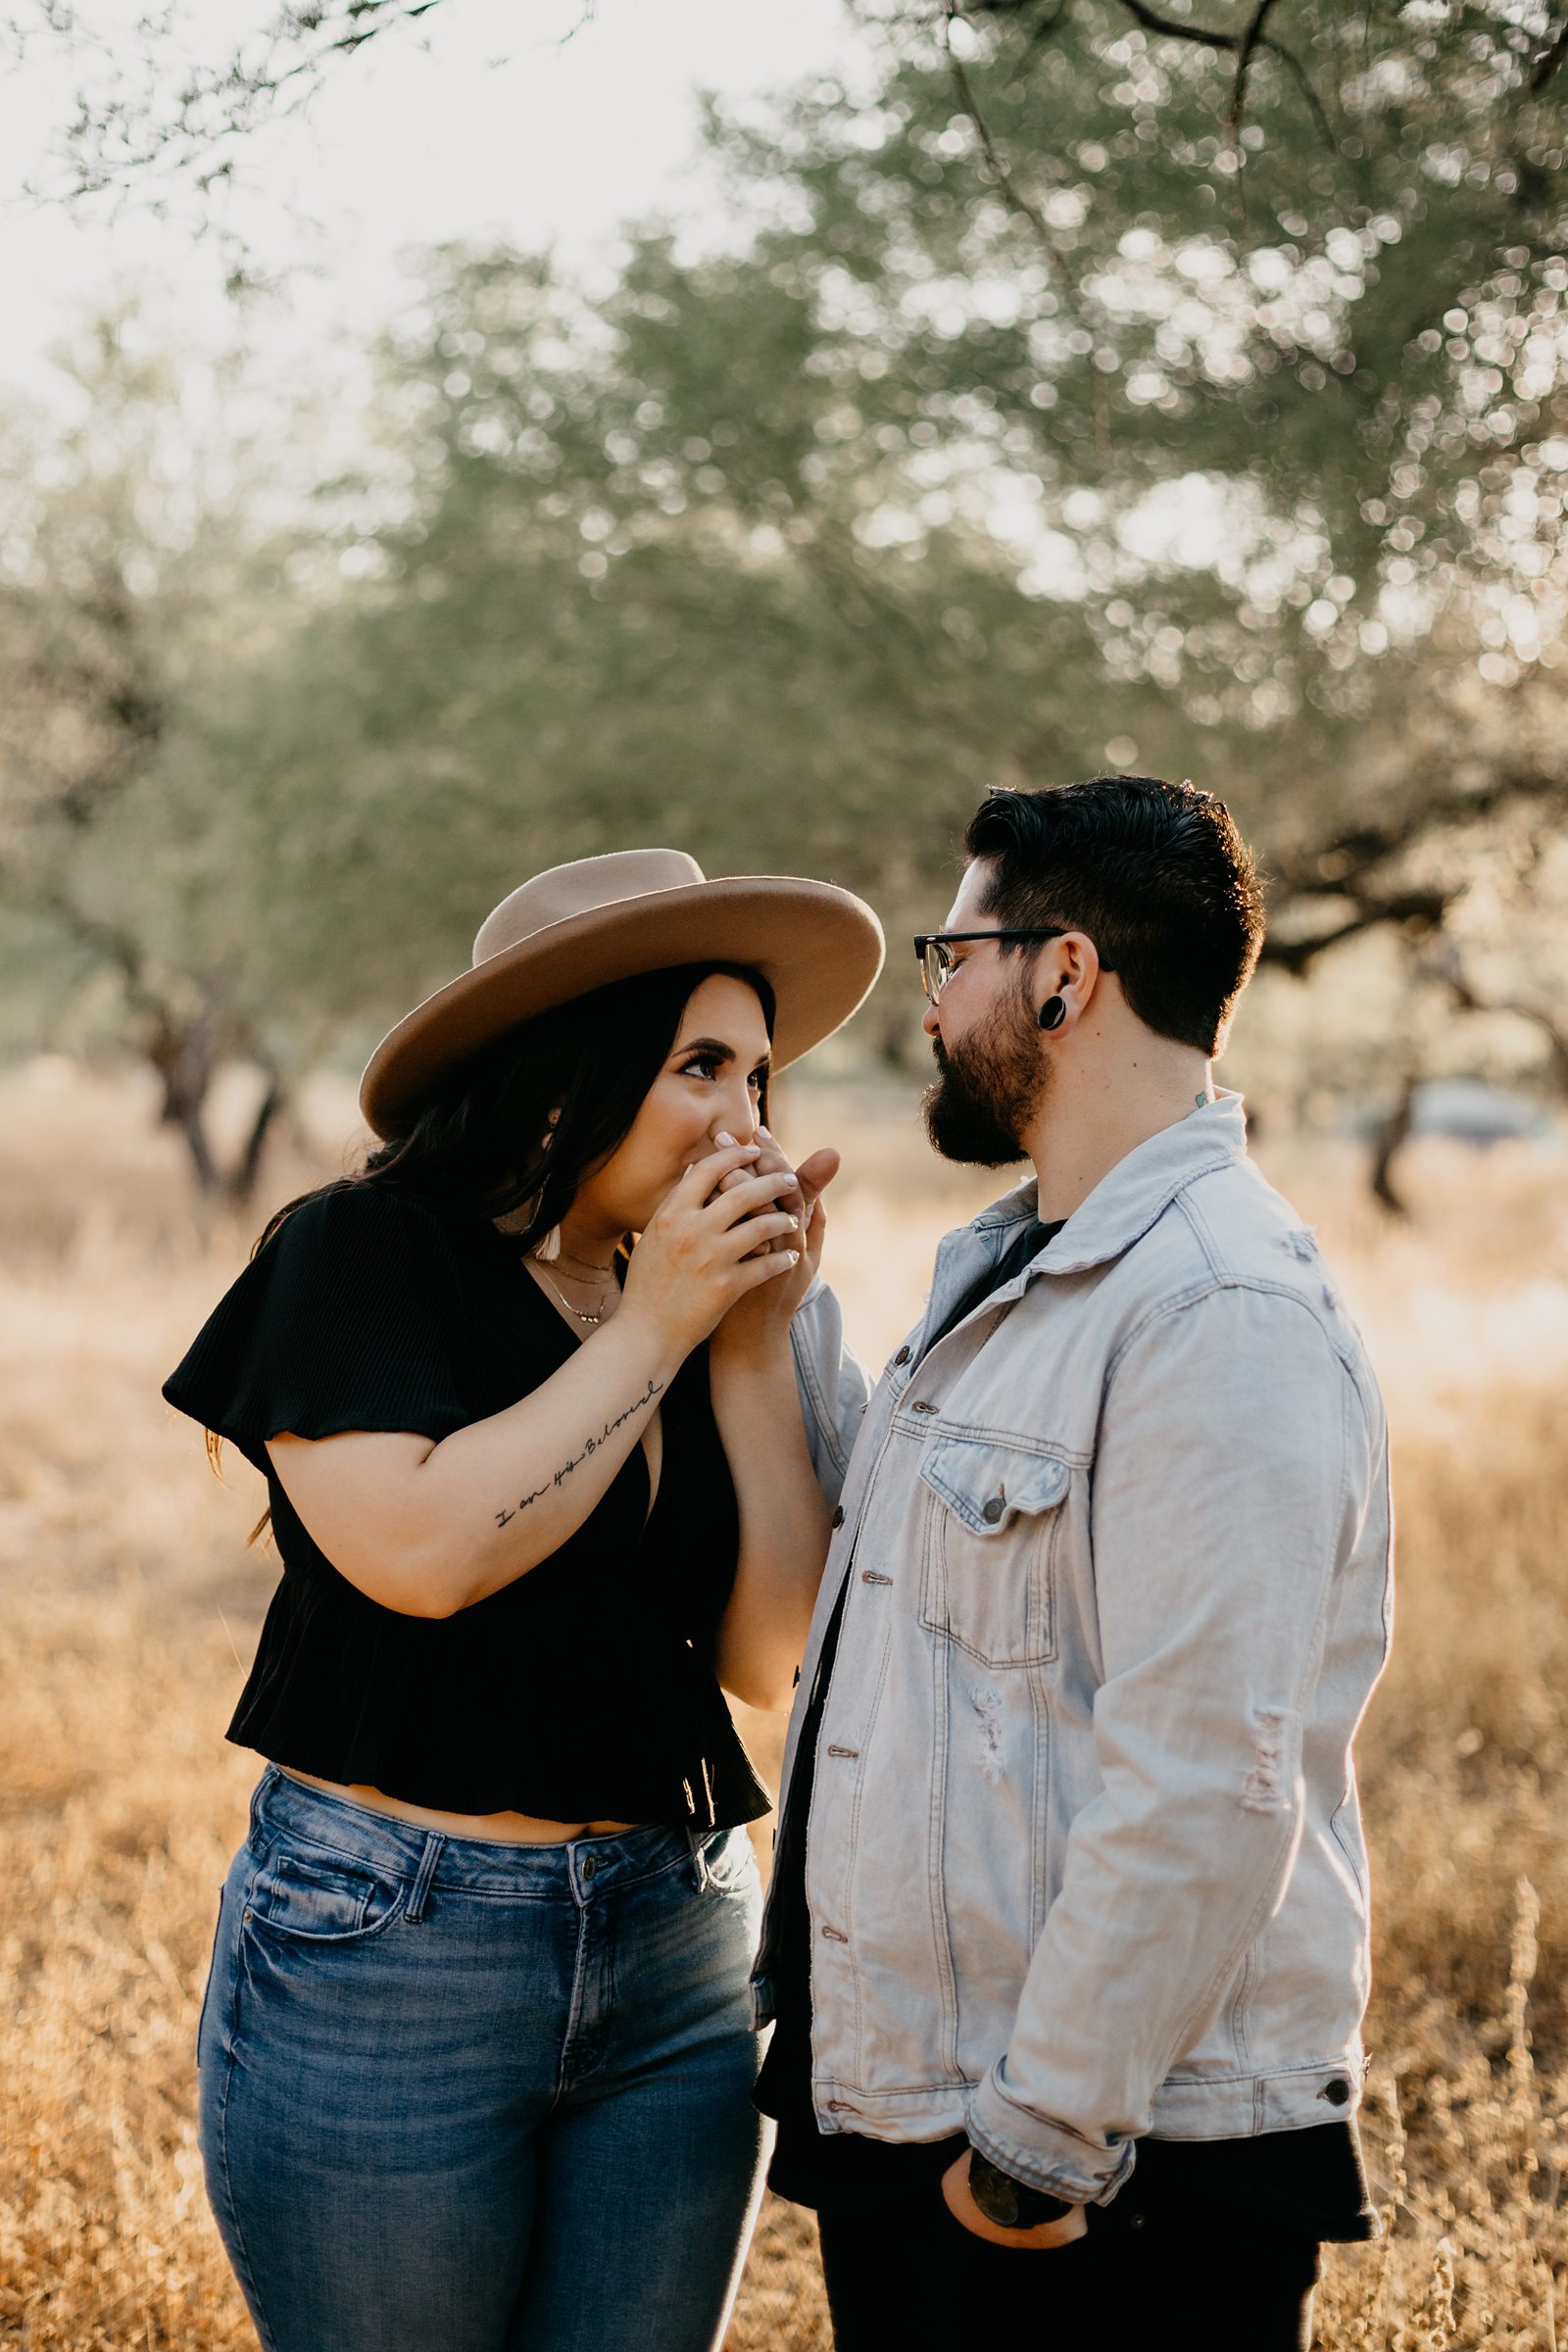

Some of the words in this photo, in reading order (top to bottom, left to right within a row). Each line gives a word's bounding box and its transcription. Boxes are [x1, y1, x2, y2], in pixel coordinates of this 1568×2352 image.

[495, 1509, 516, 1528] I
[519, 1482, 551, 1509] am
[585, 1380, 663, 1454] Beloved
